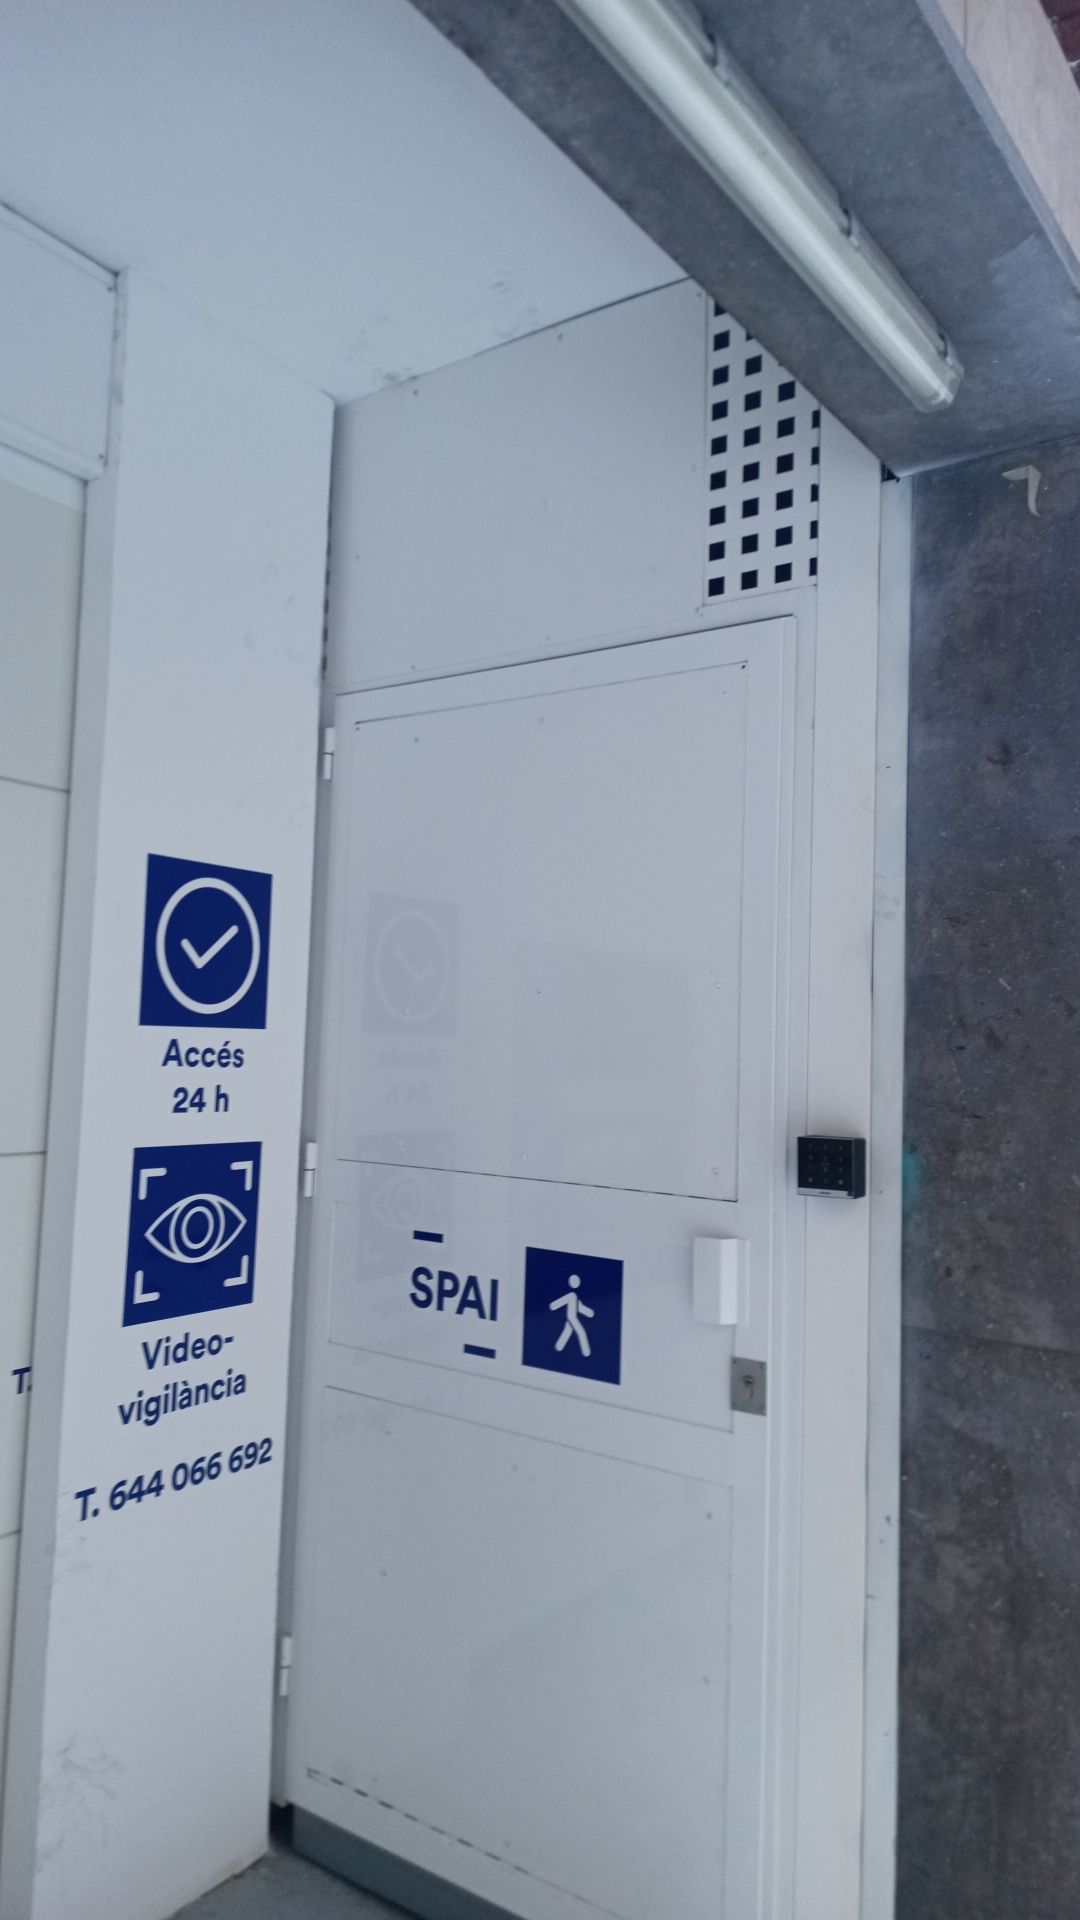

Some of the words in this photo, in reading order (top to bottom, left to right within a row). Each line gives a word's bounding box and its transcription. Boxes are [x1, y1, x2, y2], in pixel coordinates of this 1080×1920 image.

[161, 1038, 244, 1069] Accés
[172, 1086, 207, 1114] 24
[214, 1084, 229, 1113] h
[409, 1266, 499, 1322] SPAI
[141, 1332, 234, 1371] Video-
[117, 1368, 247, 1427] vigilància
[74, 1486, 100, 1522] T.
[108, 1469, 165, 1511] 644
[171, 1451, 223, 1492] 066
[228, 1437, 273, 1474] 692
